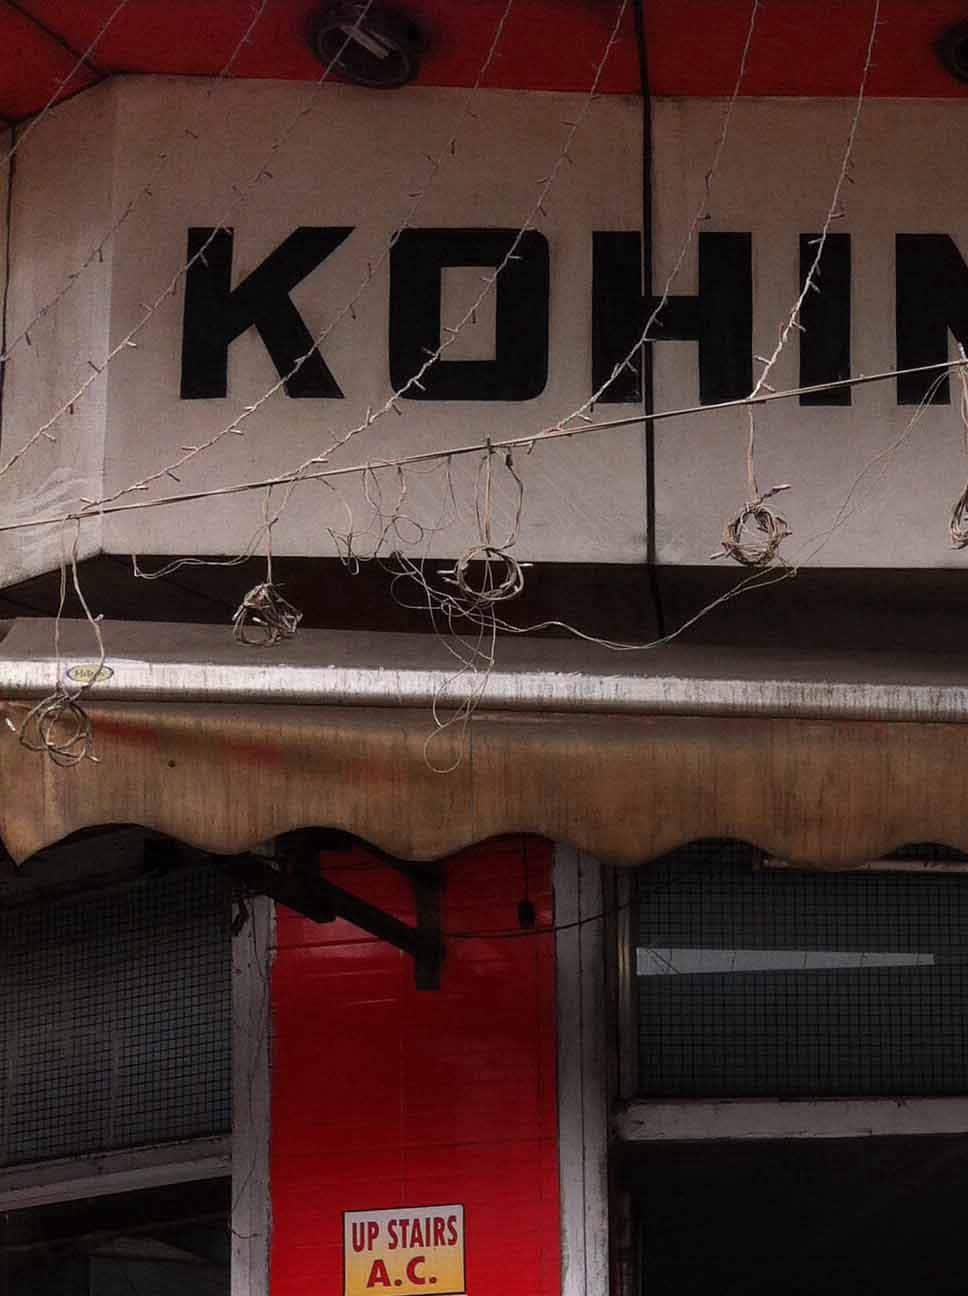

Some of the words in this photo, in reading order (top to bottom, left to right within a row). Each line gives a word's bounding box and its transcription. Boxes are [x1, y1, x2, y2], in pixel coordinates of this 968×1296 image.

[352, 1221, 379, 1252] UP
[388, 1215, 458, 1250] STAIRS
[366, 1256, 438, 1288] A.C.
